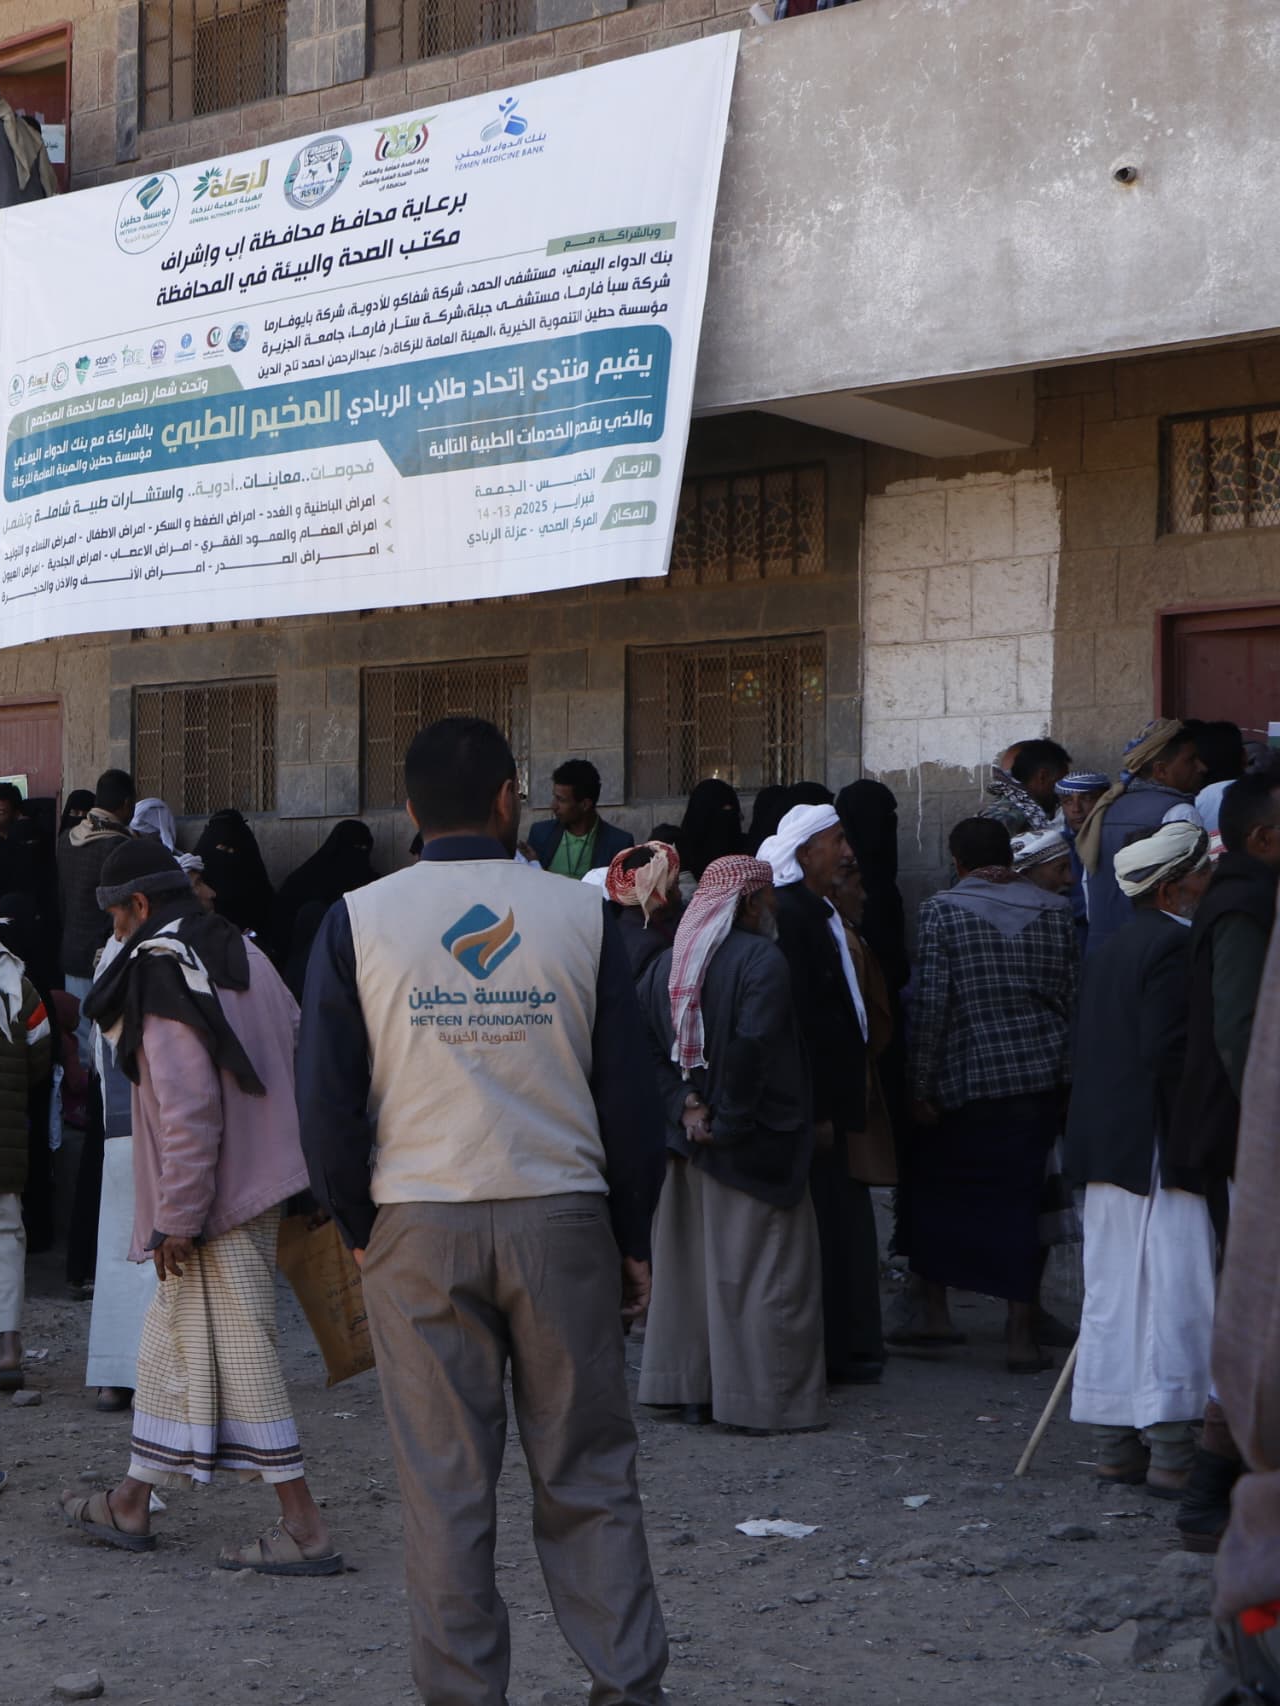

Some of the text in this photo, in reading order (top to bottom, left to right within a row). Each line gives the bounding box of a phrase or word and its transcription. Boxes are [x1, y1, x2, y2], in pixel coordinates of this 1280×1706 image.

[454, 145, 545, 172] YEMEN MEDICINE BANK
[161, 192, 467, 273] برعاية محافظ محافظة إب وإشراف
[563, 226, 661, 251] وبالشراكة مع
[156, 228, 460, 306] مكتب الصحة والبيئة في المحافظة
[608, 252, 646, 271] الدواء
[650, 251, 672, 266] بنك
[504, 268, 556, 286] مستشفى
[632, 272, 670, 293] شركة
[432, 281, 463, 301] شركة
[607, 279, 628, 295] سبأ
[392, 287, 429, 311] شفاكو
[496, 290, 559, 311] مستشفى
[315, 303, 344, 322] شركة
[584, 307, 615, 322] حطين
[618, 301, 667, 317] مؤسسة
[264, 311, 312, 333] بايوفارما
[388, 315, 420, 335] ستار
[499, 318, 535, 337] الخيرية
[539, 310, 582, 330] التنموية
[261, 335, 301, 356] الجزيرة
[303, 328, 344, 346] جامعة
[425, 332, 457, 347] العامة
[257, 363, 281, 379] الدين
[283, 359, 298, 376] تاج
[301, 355, 324, 369] احمد
[149, 380, 177, 404] شعار
[179, 377, 208, 394] وتحت
[346, 348, 652, 425] يقيم منتدى إتحاد طلاب الربادي
[66, 398, 95, 417] لخدمة
[29, 406, 64, 432] المجتمع
[161, 389, 340, 453] المخيم الطبي
[429, 409, 652, 459] والذي يقدم الخدمات الطبية التالية
[13, 423, 153, 471] بالشراكة مع بنك الدواء اليمني
[114, 447, 152, 463] مؤسسة
[56, 459, 87, 476] والهيئة
[89, 455, 113, 470] حطين
[613, 460, 652, 482] الزمان
[33, 465, 55, 482] العامة
[475, 468, 595, 497] الخميس الجمعة
[73, 496, 108, 514] طبية
[111, 484, 183, 510] واستشارات
[345, 494, 375, 511] امراض
[552, 493, 594, 513] فبراير
[34, 500, 70, 522] شاملة
[266, 504, 292, 519] الغدد
[304, 498, 342, 516] الباطنية
[611, 506, 648, 524] المكان
[153, 518, 181, 535] السكر
[193, 513, 223, 527] الضغط
[226, 509, 255, 525] امراض
[346, 518, 377, 535] امراض
[86, 527, 116, 543] الاطفال
[118, 522, 145, 538] امراض
[246, 528, 296, 547] والعمود
[466, 512, 597, 547] المركز الصحي عزلة الربادي
[51, 532, 76, 549] امراض
[154, 539, 191, 556] امراض
[200, 534, 242, 553] الفقري
[76, 550, 101, 566] امراض
[110, 544, 152, 559] الاعصاب
[300, 542, 379, 564] امراض
[47, 554, 74, 569] الجلدية
[144, 560, 205, 580] امراض
[214, 551, 297, 574] الصدر
[1, 580, 53, 604] والحنجرة
[408, 985, 557, 1010] مؤسسة حطين
[410, 1014, 553, 1026] HETEEN FOUNDATION
[438, 1031, 526, 1045] التنموية الخيرية
